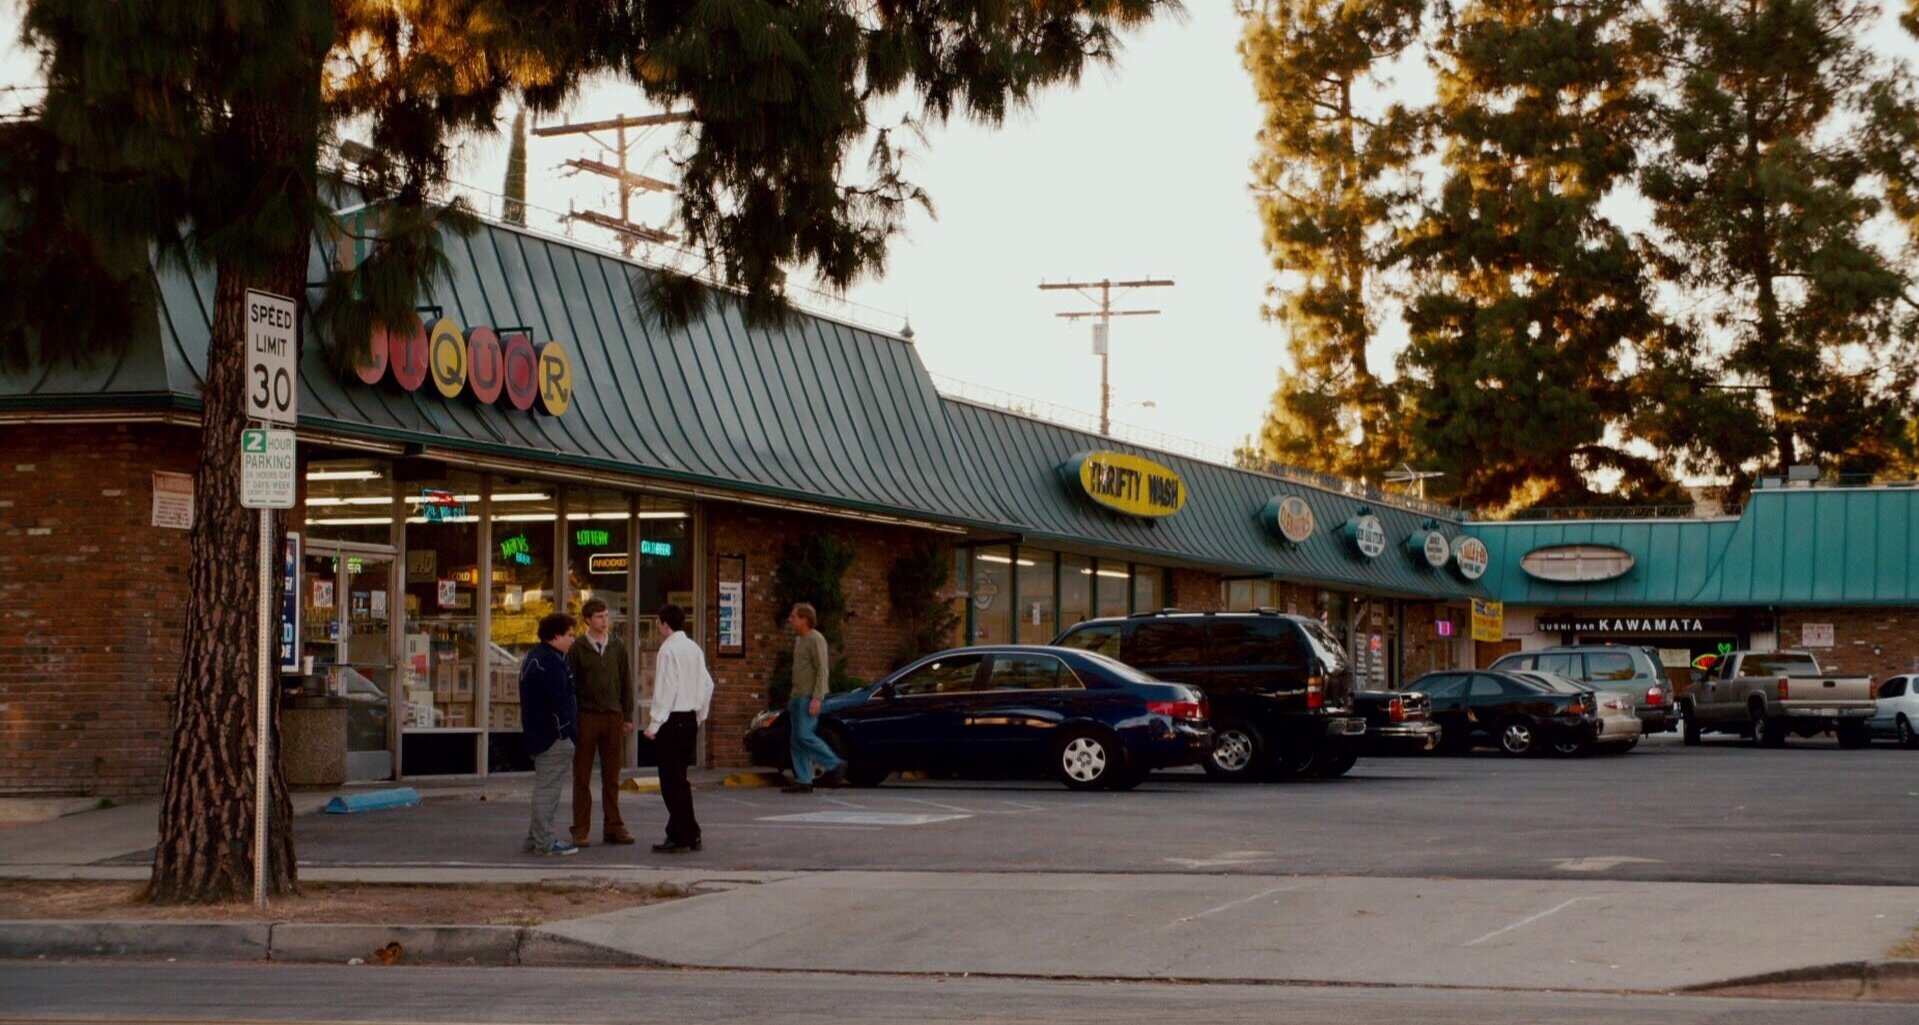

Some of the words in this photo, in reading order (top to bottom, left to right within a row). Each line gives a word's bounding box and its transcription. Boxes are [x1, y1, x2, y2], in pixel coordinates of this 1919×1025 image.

[251, 304, 292, 330] SPEED
[256, 333, 288, 357] LIMIT
[252, 363, 292, 412] 30
[246, 432, 263, 451] 2
[268, 438, 292, 450] HOUR
[245, 454, 292, 470] PARKING
[253, 480, 270, 489] DAYS
[272, 480, 291, 489] WEEK
[1088, 460, 1142, 502] THRIFTY
[1147, 473, 1179, 509] WASH
[576, 529, 609, 546] LOTTERY
[655, 542, 671, 556] BEER
[1539, 623, 1571, 631] SUSHI
[1575, 623, 1595, 631] BAR
[1599, 618, 1703, 632] KAWAMATA
